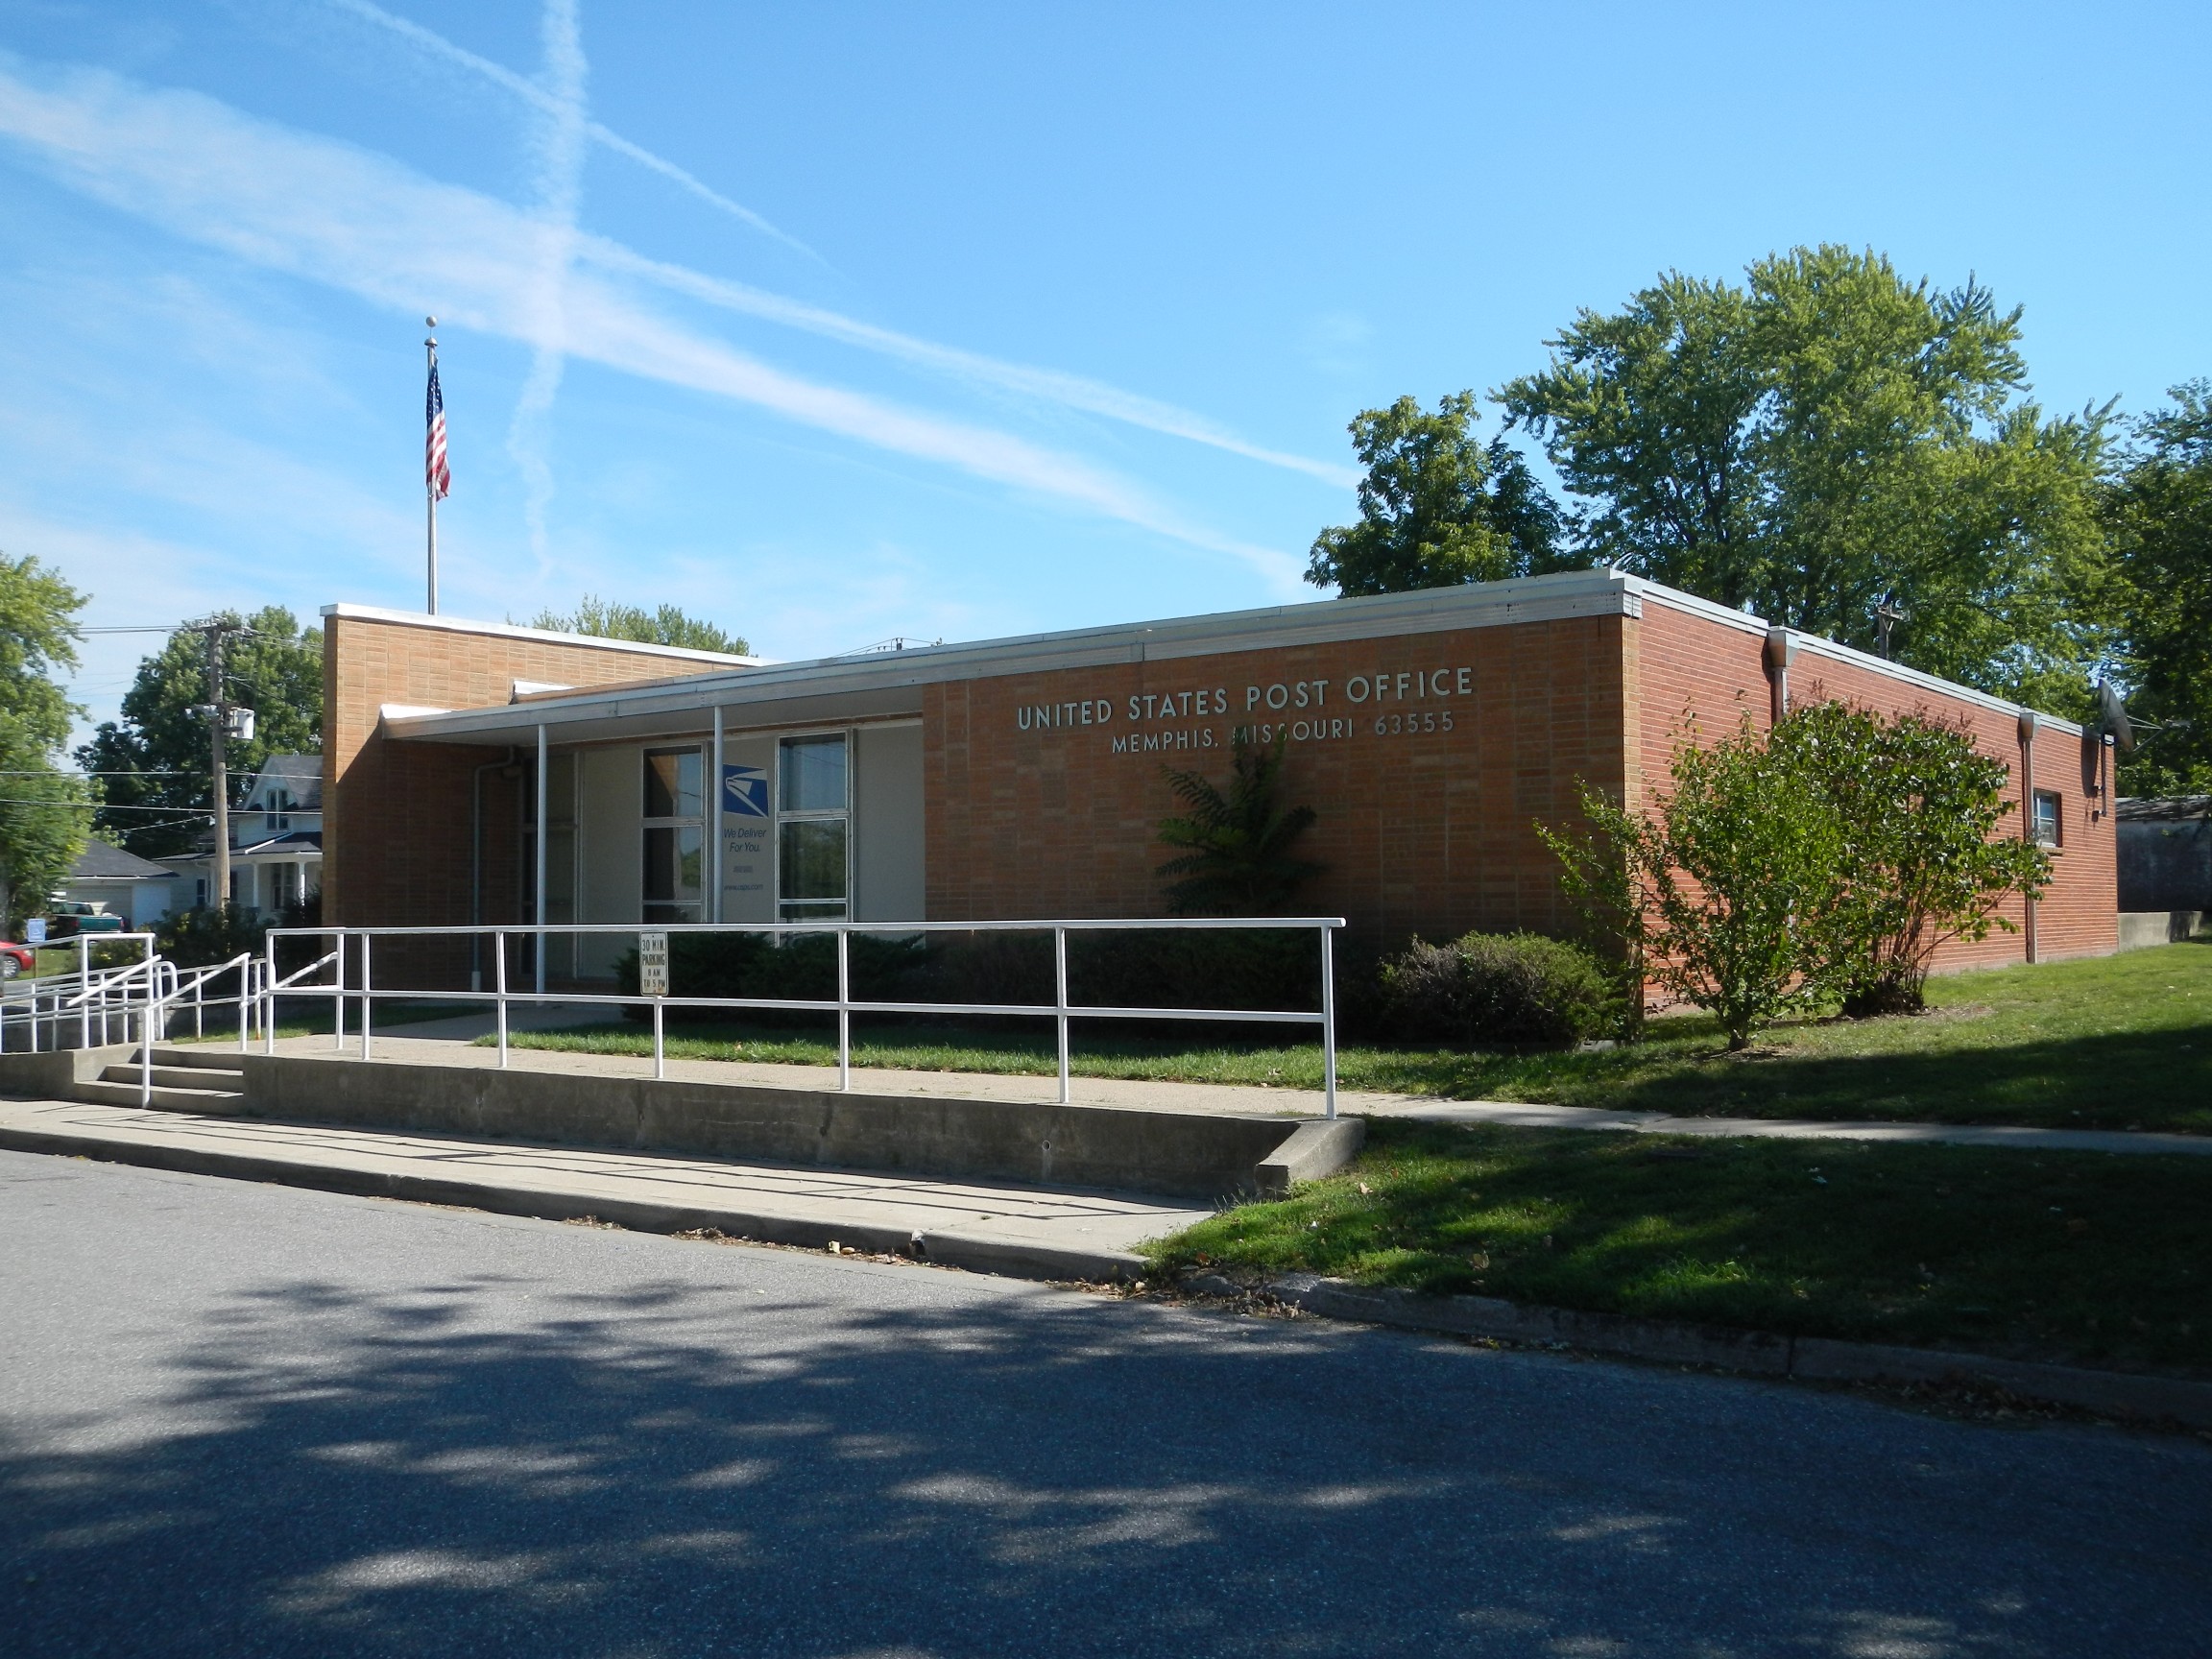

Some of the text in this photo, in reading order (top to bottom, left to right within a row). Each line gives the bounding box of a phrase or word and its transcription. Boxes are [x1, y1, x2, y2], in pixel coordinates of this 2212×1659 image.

[1018, 667, 1473, 730] UNITED STATES POST OFFICE
[1112, 728, 1219, 754] MEMPHIS,
[1375, 710, 1455, 735] 63555
[724, 828, 766, 838] We Deliver
[730, 842, 742, 852] For
[642, 940, 650, 951] 30
[642, 954, 665, 966] PARKING
